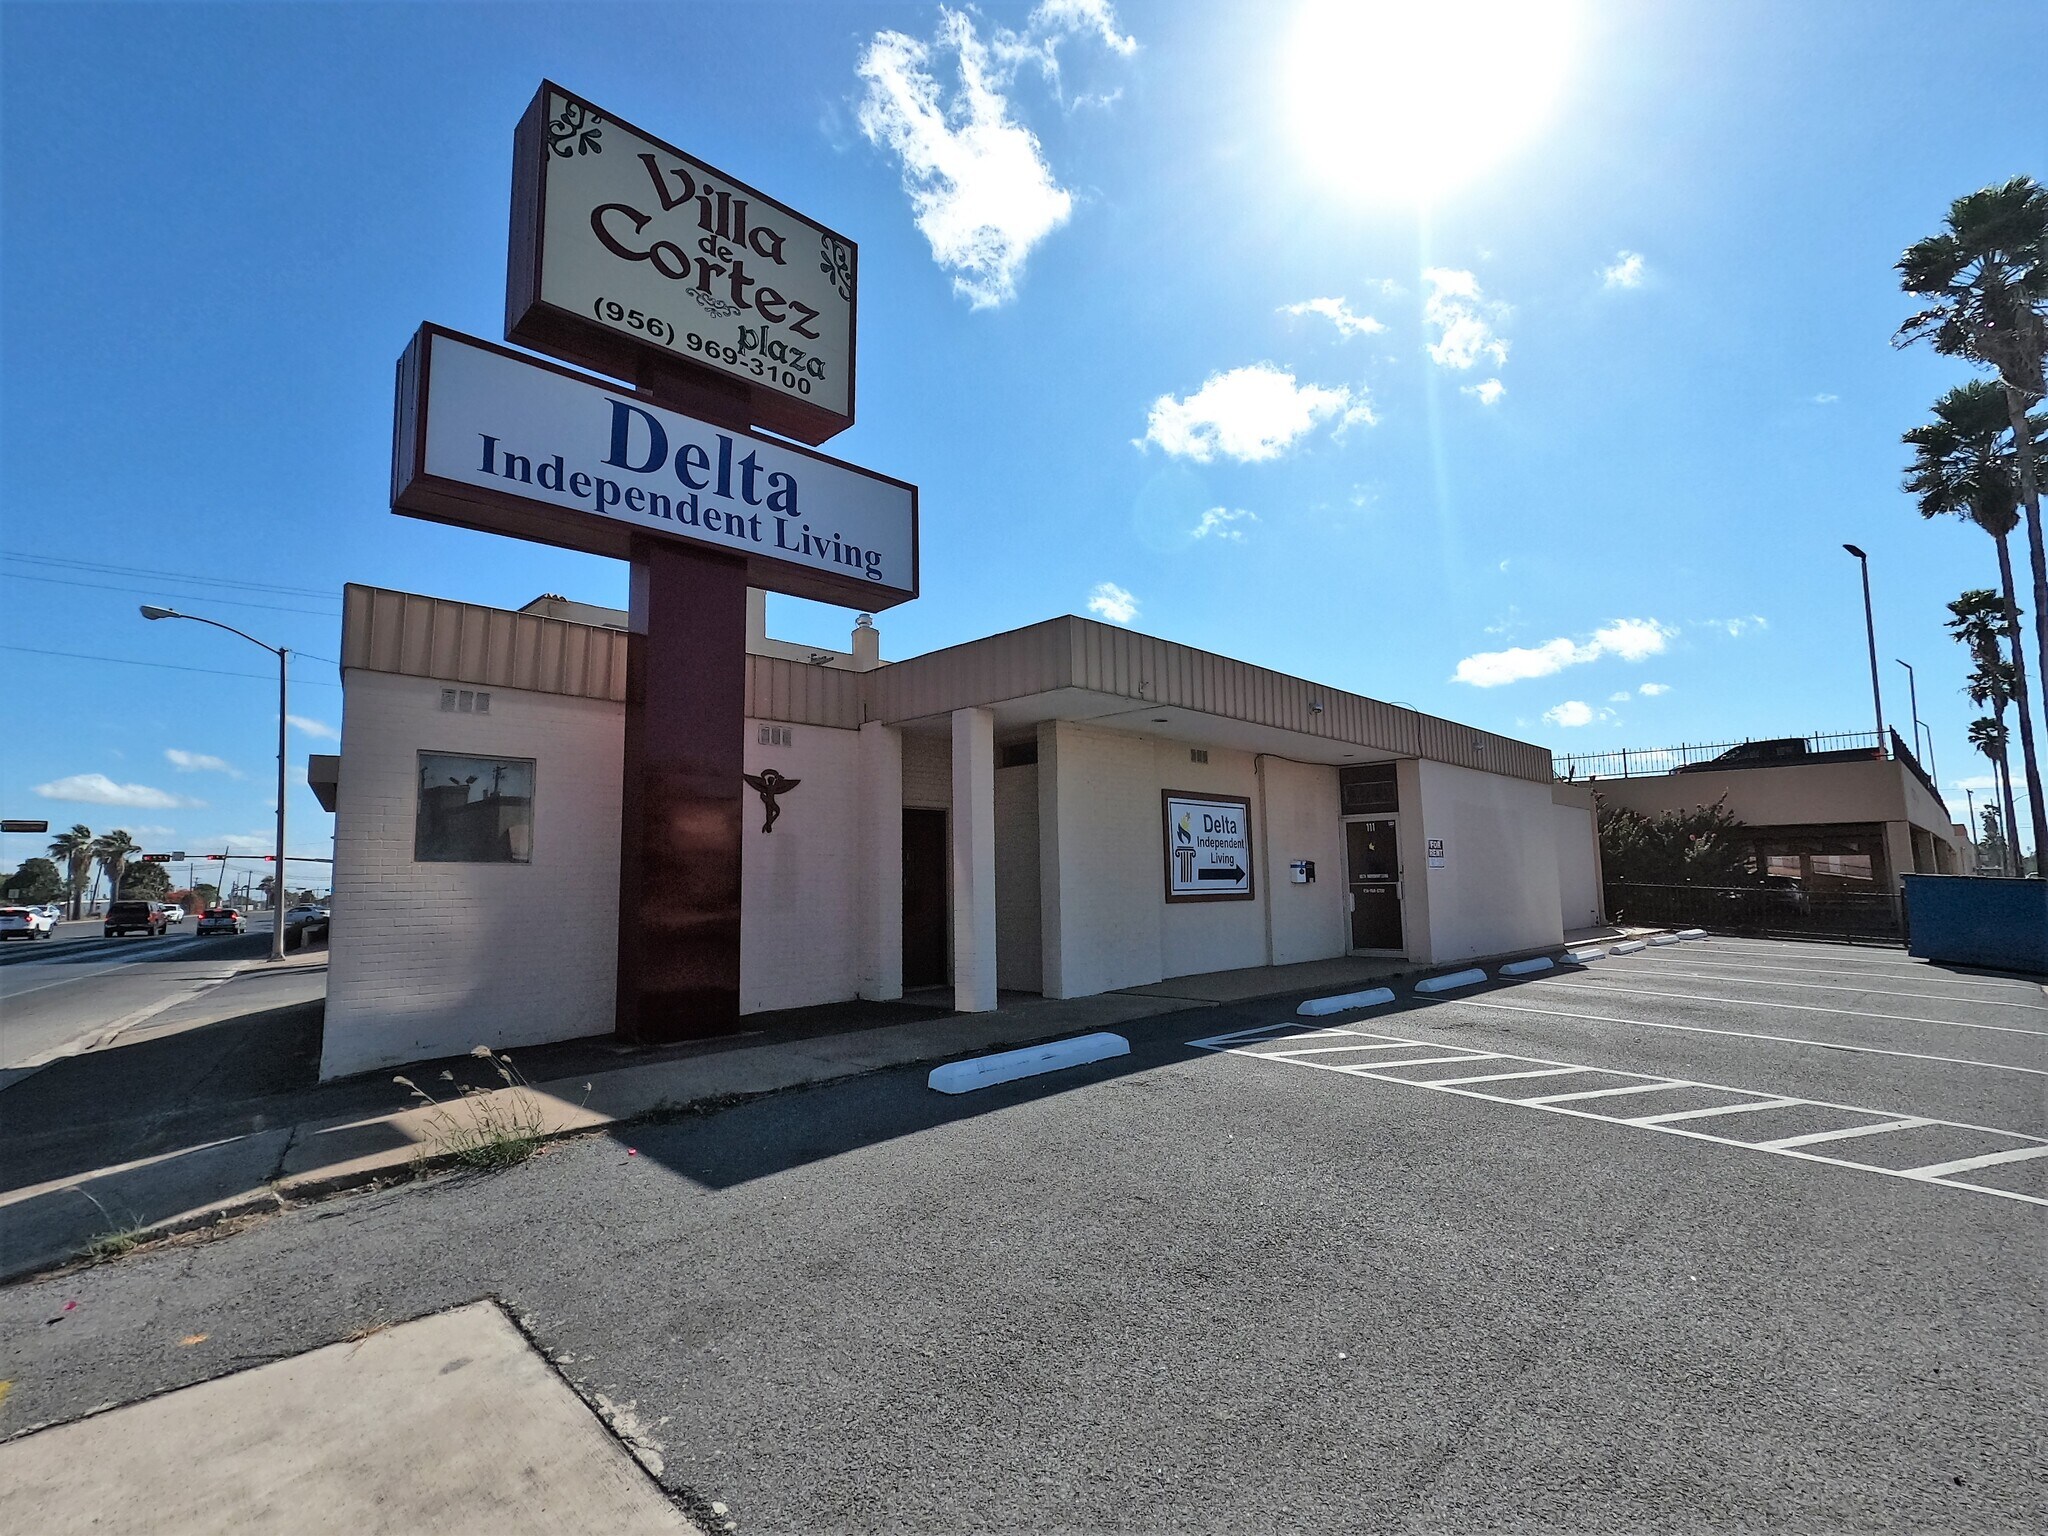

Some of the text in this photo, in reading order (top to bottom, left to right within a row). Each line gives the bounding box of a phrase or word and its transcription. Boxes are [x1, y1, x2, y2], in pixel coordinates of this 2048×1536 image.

[636, 153, 787, 266] Villa
[697, 233, 734, 263] de
[590, 203, 820, 340] Cortez
[593, 297, 812, 395] (956) 969-3100
[737, 324, 827, 381] plaza
[600, 397, 802, 517] Delta
[476, 432, 883, 581] Independent Living
[1197, 836, 1245, 850] Independent
[1203, 814, 1237, 834] Delta
[1366, 822, 1376, 832] 111
[1429, 840, 1442, 849] FOR
[1210, 852, 1235, 867] Living
